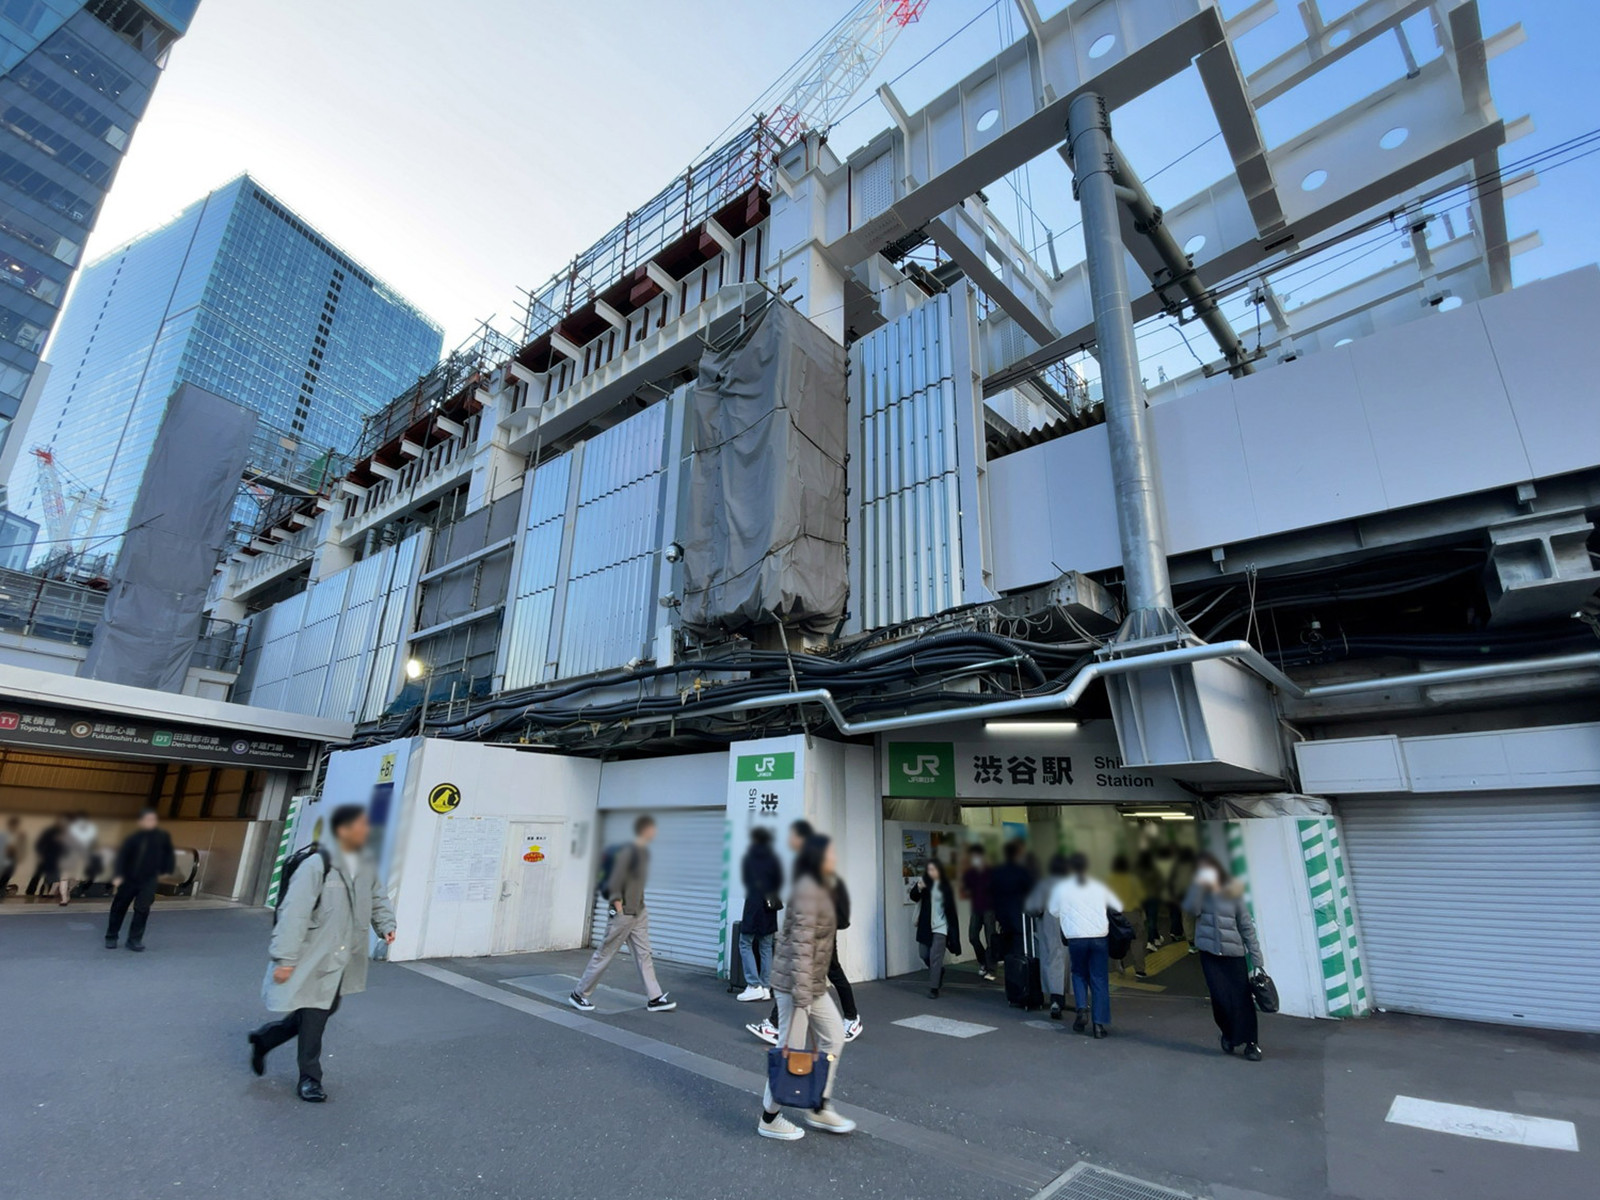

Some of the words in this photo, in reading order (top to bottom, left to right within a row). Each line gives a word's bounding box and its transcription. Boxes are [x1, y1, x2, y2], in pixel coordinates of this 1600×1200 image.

[1, 716, 16, 725] TY
[21, 714, 56, 727] 東横線
[20, 723, 49, 733] Toyoko
[50, 727, 67, 735] Line
[92, 733, 132, 743] Fukutoshin
[133, 736, 149, 744] Line
[155, 735, 169, 743] DT
[171, 740, 215, 751] Den-en-toshi
[215, 744, 229, 752] Line
[755, 757, 776, 772] JR
[902, 754, 940, 776] JR
[1094, 756, 1124, 769] Shi
[973, 755, 1074, 786] 渋谷駅
[1096, 773, 1154, 787] Station
